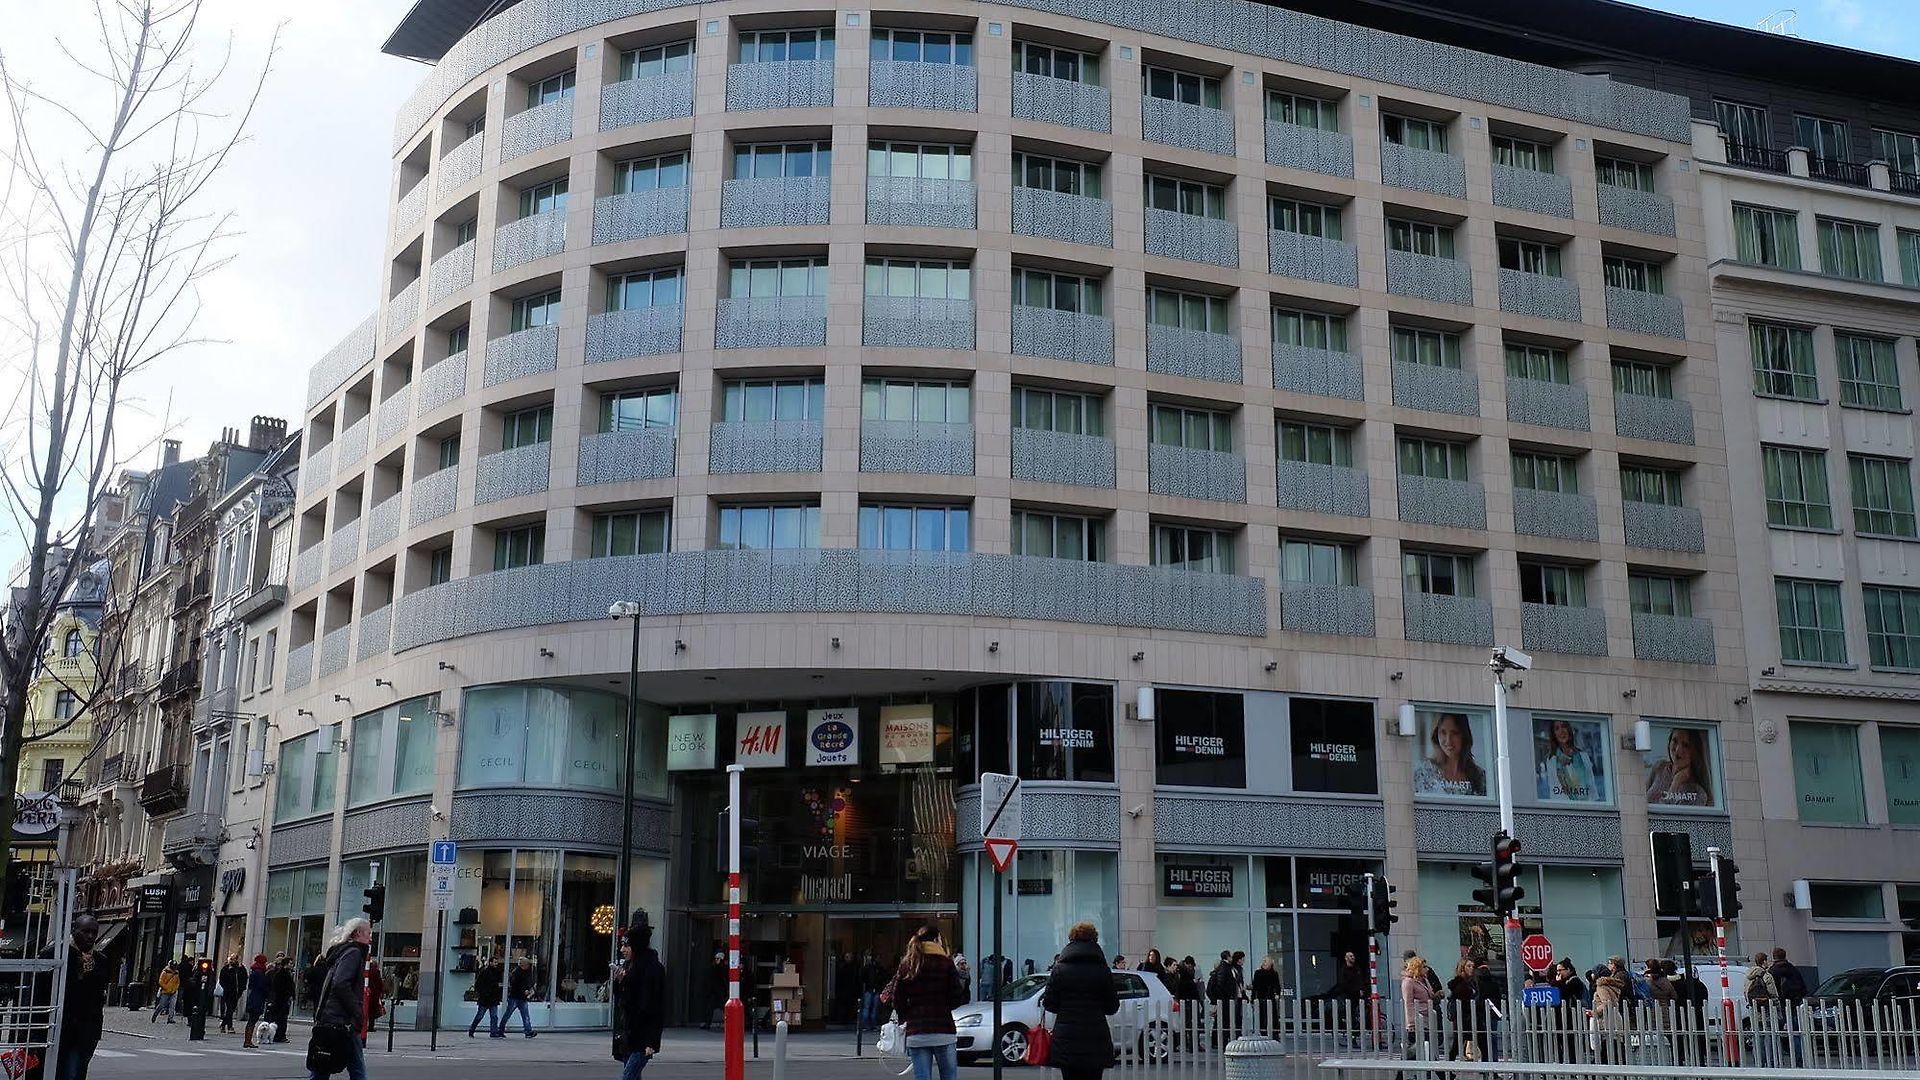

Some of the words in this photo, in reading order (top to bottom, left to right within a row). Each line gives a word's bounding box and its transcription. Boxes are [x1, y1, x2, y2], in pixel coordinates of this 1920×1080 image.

[823, 711, 844, 720] Jeux
[886, 722, 929, 732] MAISONS
[675, 732, 704, 742] NEW
[1040, 728, 1093, 740] HILFIGER
[741, 725, 782, 755] H&M
[1062, 739, 1094, 748] DENIM
[1175, 735, 1224, 747] HILFIGER
[671, 743, 706, 752] LOOK
[1195, 746, 1224, 755] DENIM
[1310, 742, 1356, 754] HILFIGER
[480, 757, 513, 767] CECIL
[816, 753, 847, 763] Jouets
[1329, 753, 1357, 762] DENIM
[574, 760, 608, 772] CECIL
[14, 811, 57, 824] PERA
[1170, 869, 1230, 883] HILFIGER
[1194, 882, 1231, 893] DENIM
[1524, 945, 1551, 960] STOP
[1531, 991, 1553, 1003] BUS
